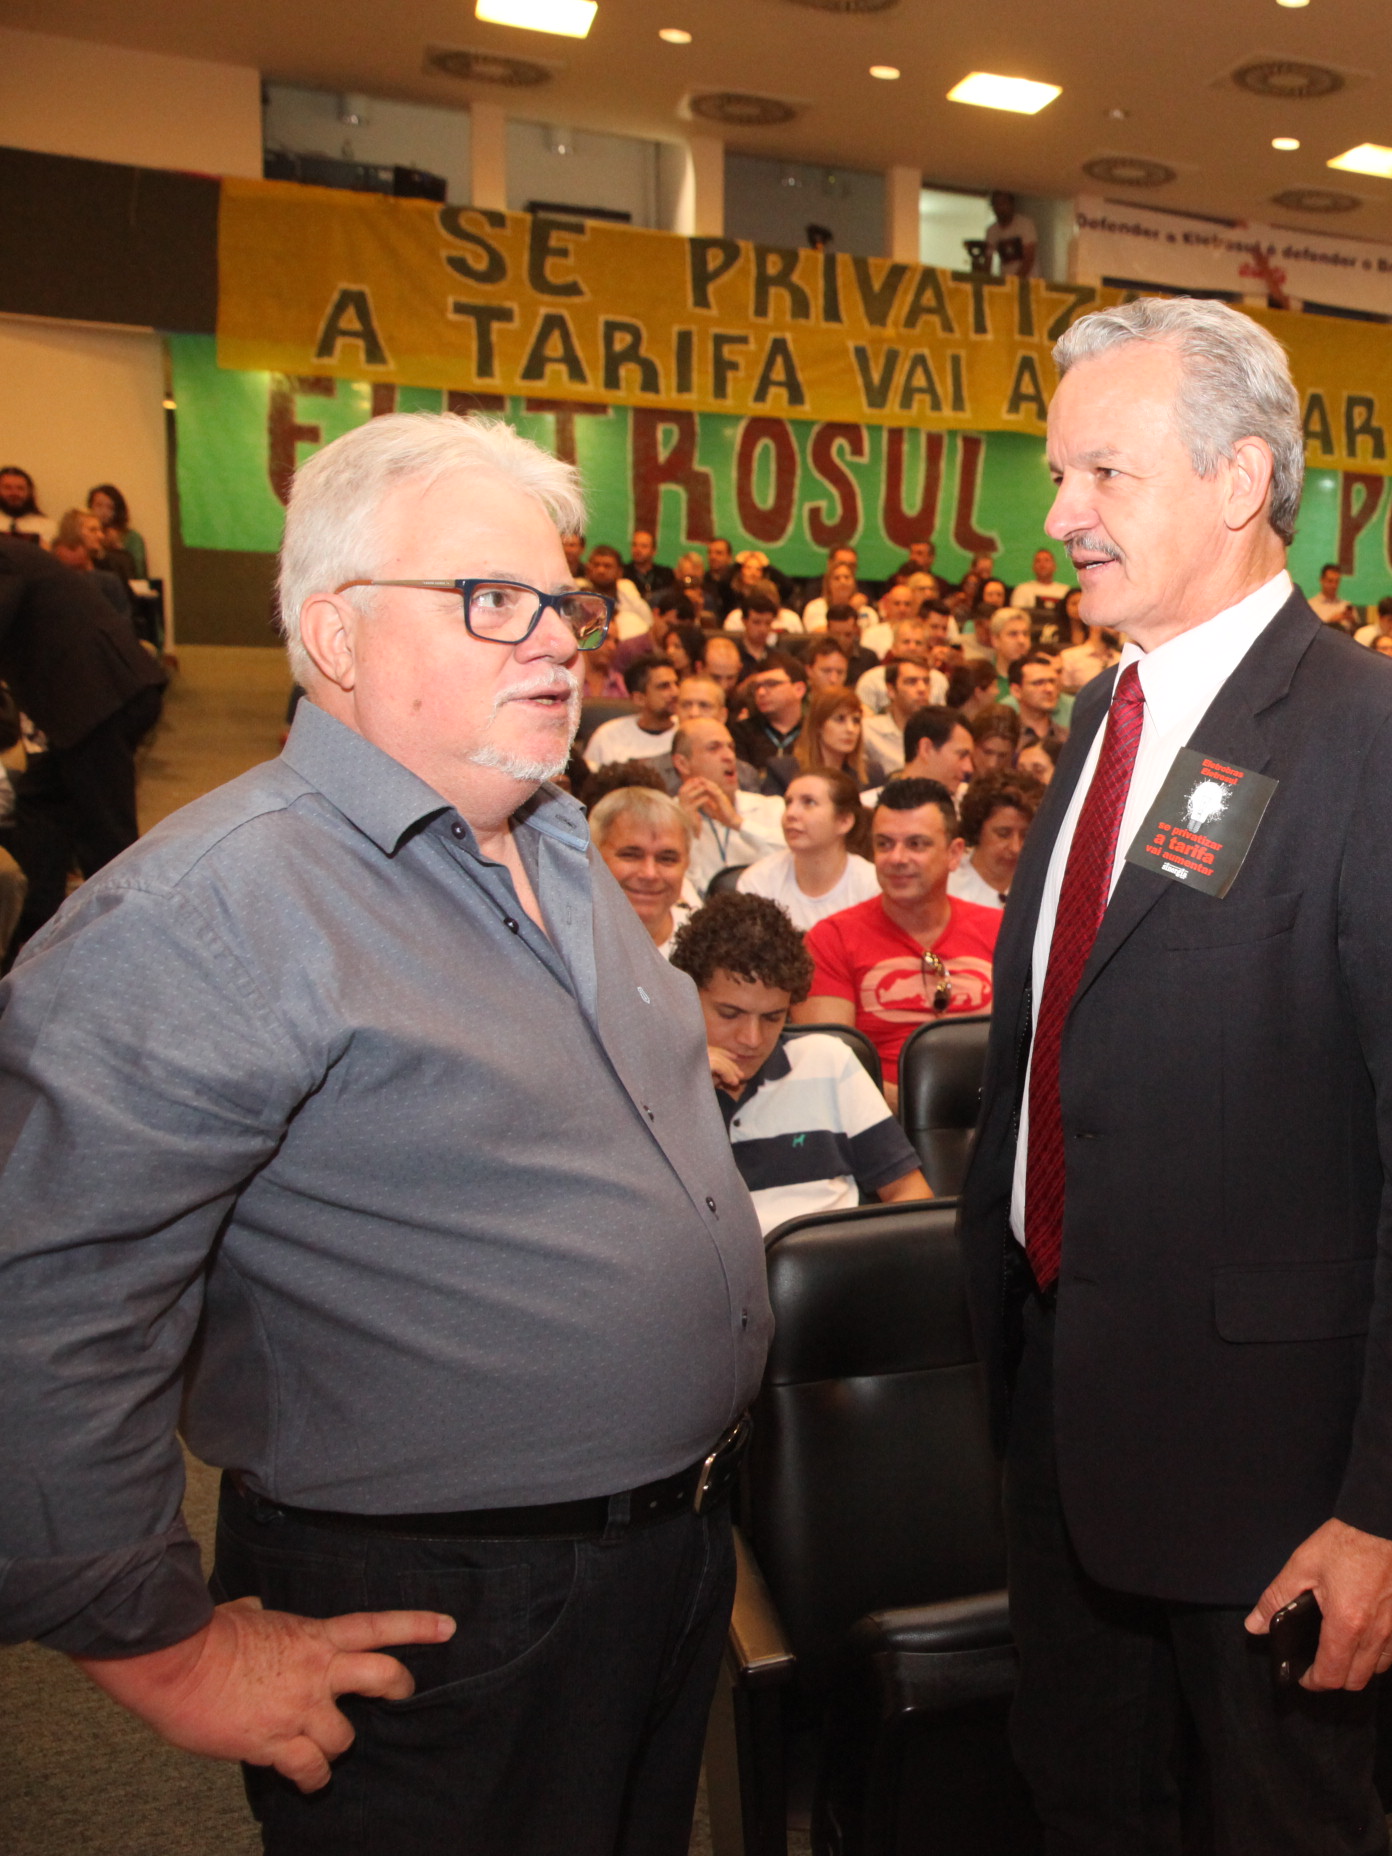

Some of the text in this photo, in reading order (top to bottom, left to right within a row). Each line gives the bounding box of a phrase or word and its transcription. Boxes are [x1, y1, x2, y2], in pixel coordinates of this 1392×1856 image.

[1076, 212, 1160, 241] Defender
[1282, 245, 1357, 268] defender
[438, 208, 1139, 342] SE PRIVATIZ
[314, 288, 390, 366] A
[450, 301, 806, 406] TARIFA
[852, 345, 967, 413] VAI
[1153, 833, 1216, 865] a tarifa
[1157, 821, 1224, 851] se privatizar
[1145, 844, 1215, 877] vai aumentar
